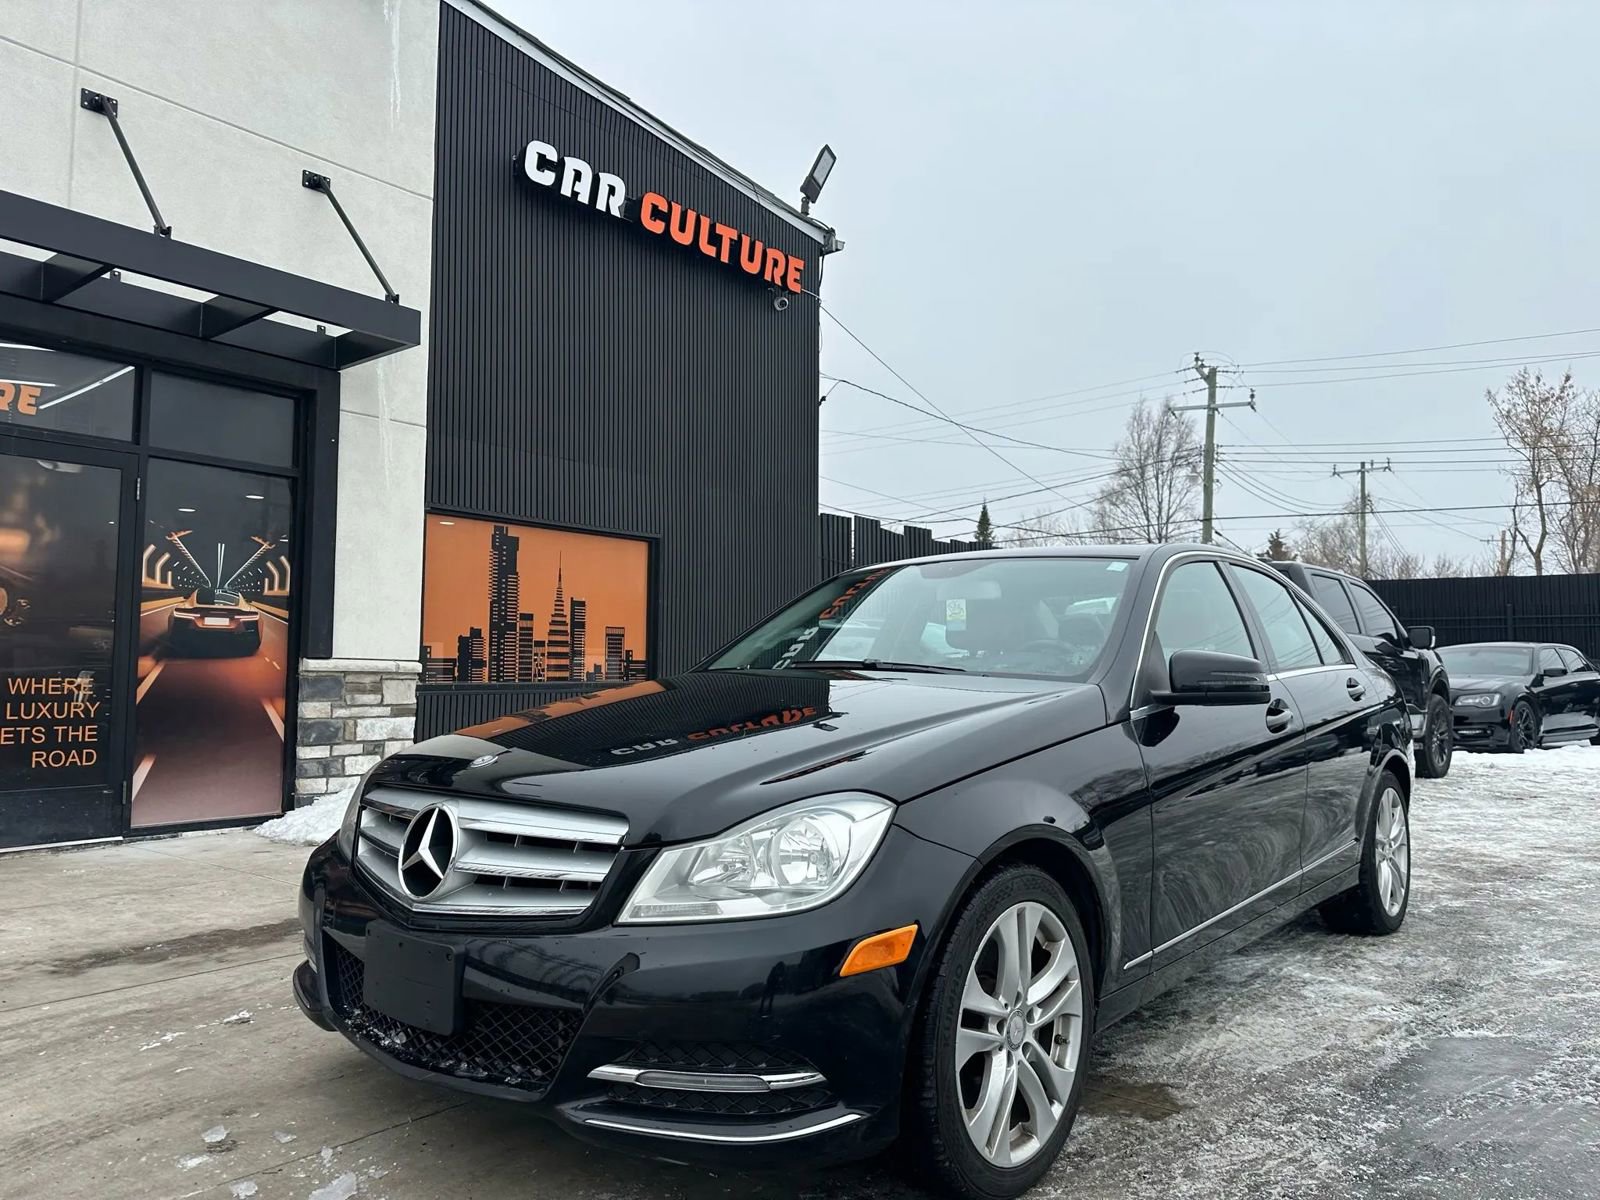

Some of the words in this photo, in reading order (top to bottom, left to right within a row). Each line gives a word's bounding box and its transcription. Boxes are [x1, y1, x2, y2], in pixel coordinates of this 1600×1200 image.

[524, 140, 626, 218] CAR
[640, 192, 804, 293] CULTURE
[8, 677, 94, 695] WHERE
[6, 702, 101, 720] LUXURY
[53, 725, 98, 743] THE
[31, 749, 97, 768] ROAD
